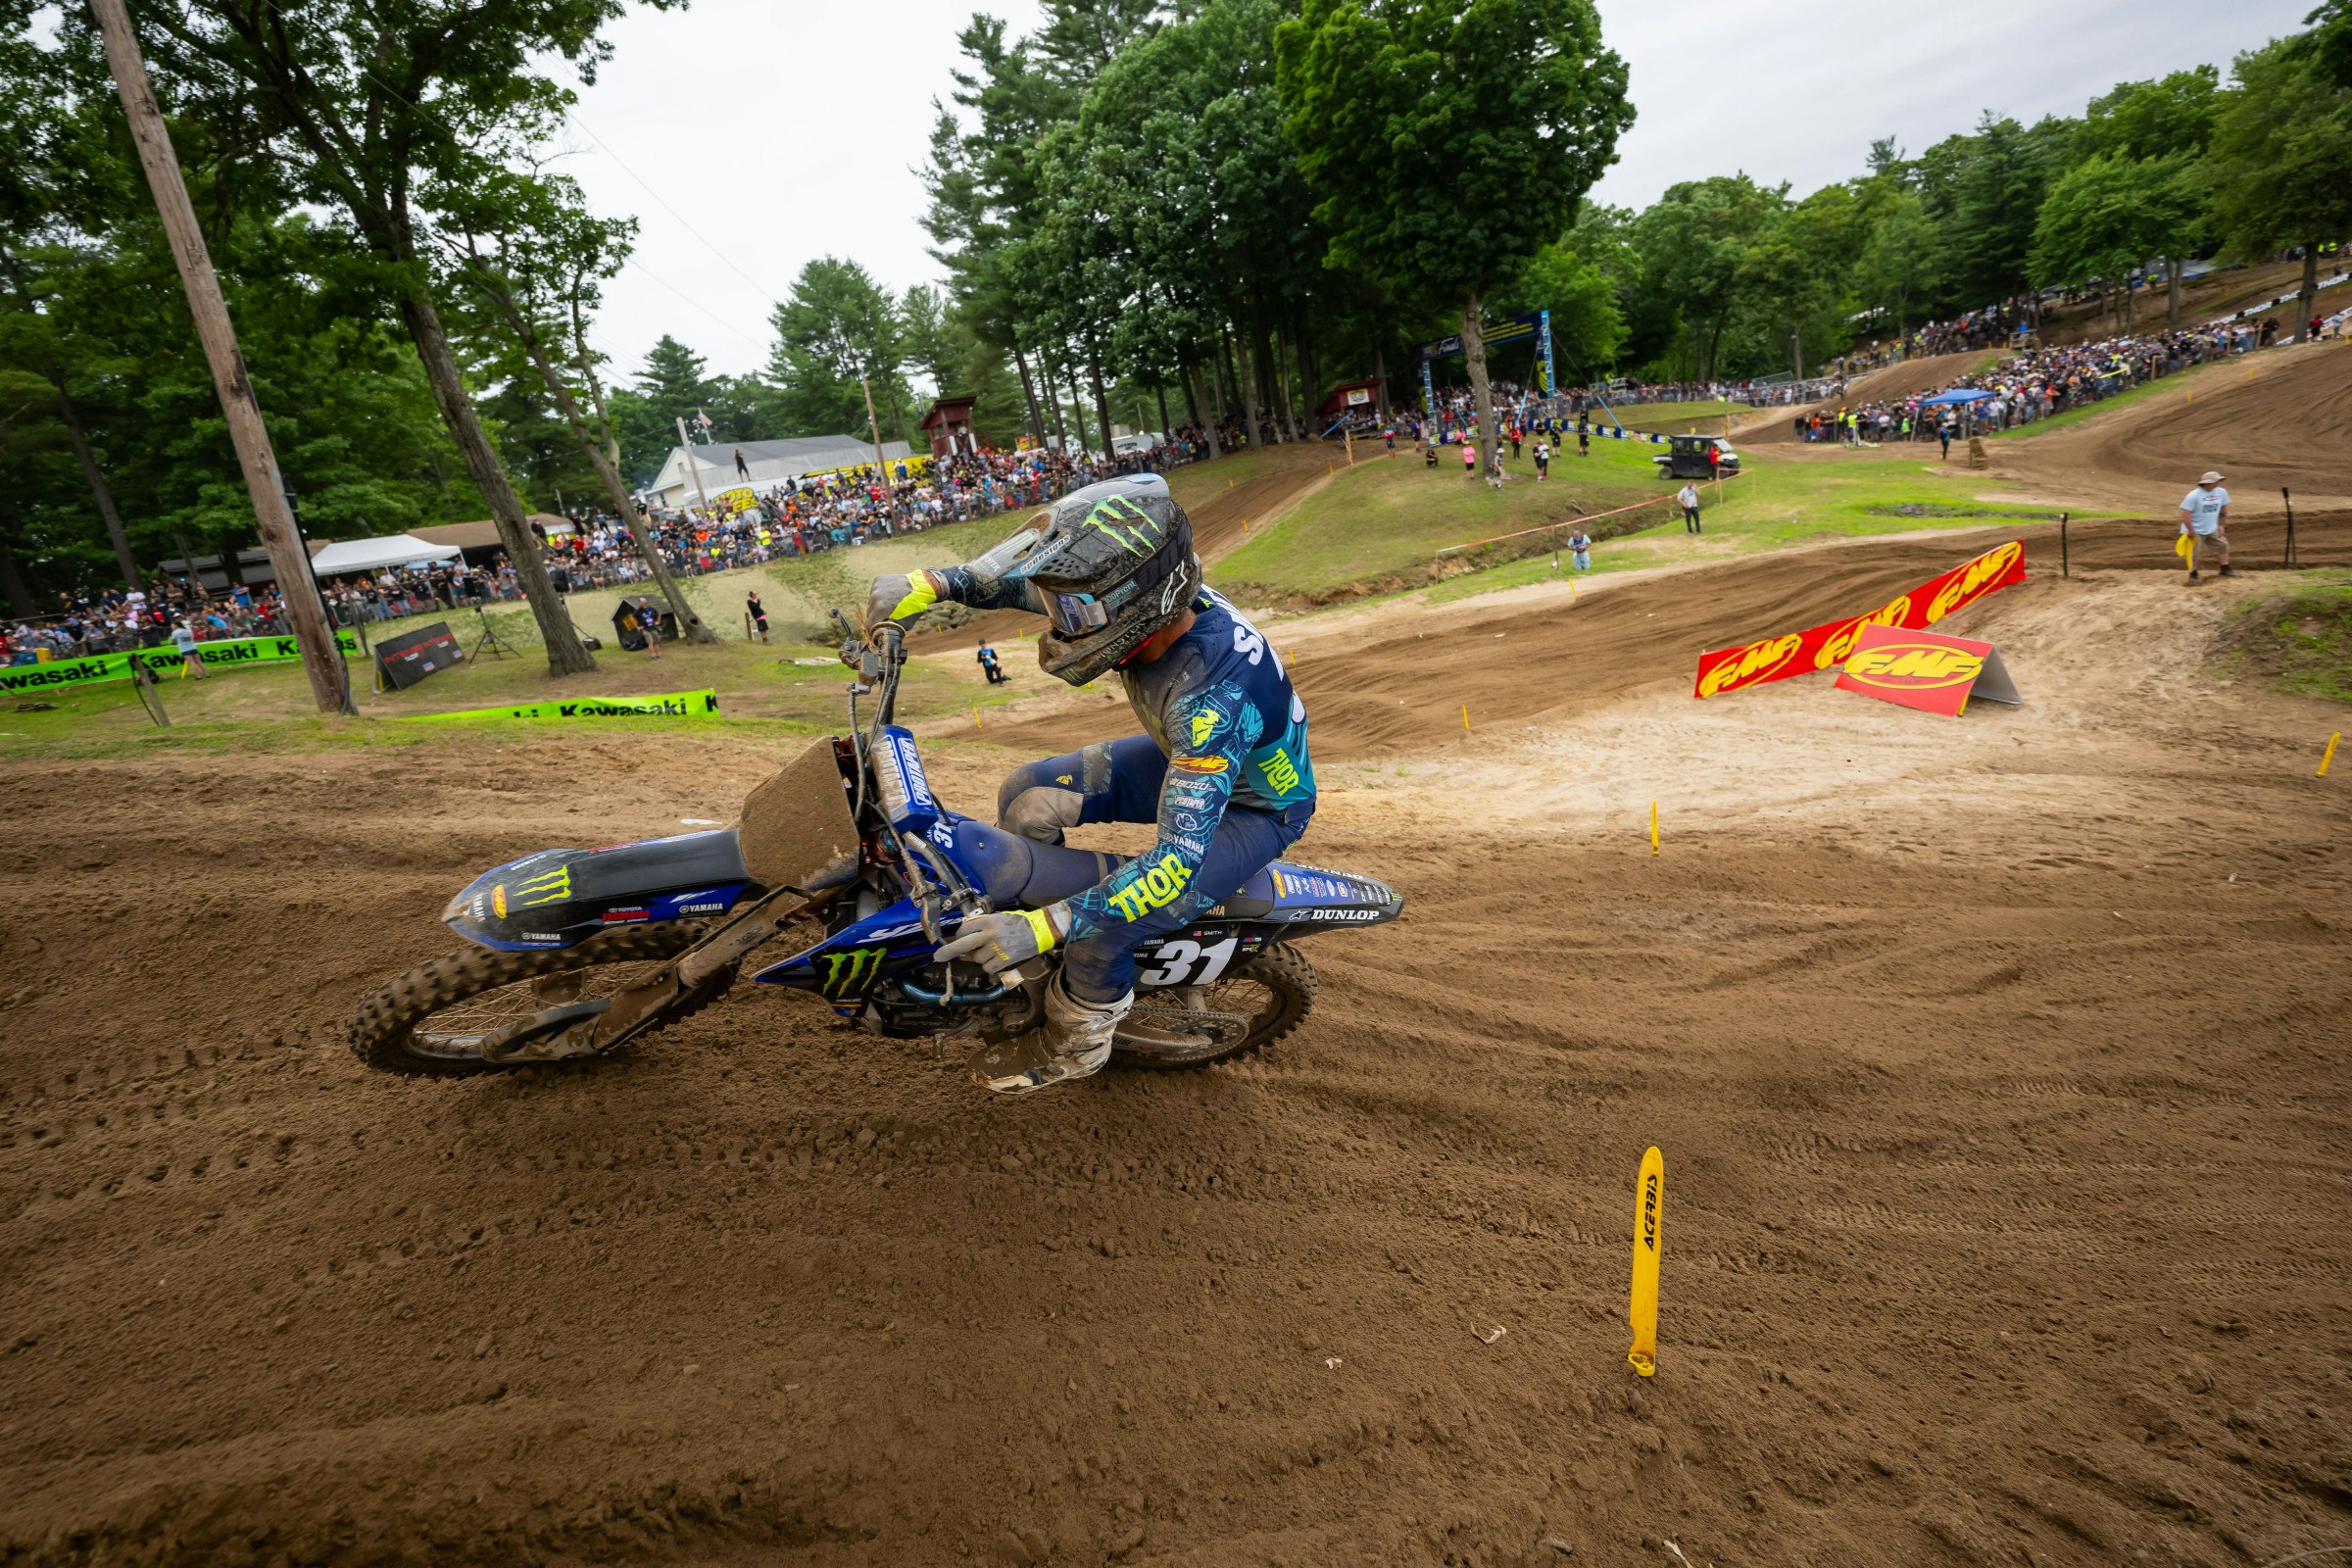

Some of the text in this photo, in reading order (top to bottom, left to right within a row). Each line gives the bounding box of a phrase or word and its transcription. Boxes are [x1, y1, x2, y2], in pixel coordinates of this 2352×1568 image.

[1927, 541, 2022, 623] FMF
[0, 661, 108, 690] wasaki
[1699, 633, 1801, 697] FMF
[1843, 648, 1984, 681] FMF
[1257, 748, 1299, 797] THOR
[933, 821, 954, 849] 31
[1173, 834, 1204, 857] YAMAHA
[690, 903, 723, 914] YAMAHA
[1107, 853, 1193, 923] THOR
[1311, 909, 1380, 920] DUNLOP
[1140, 937, 1239, 986] 31
[1643, 1174, 1658, 1252] ACERBIS
